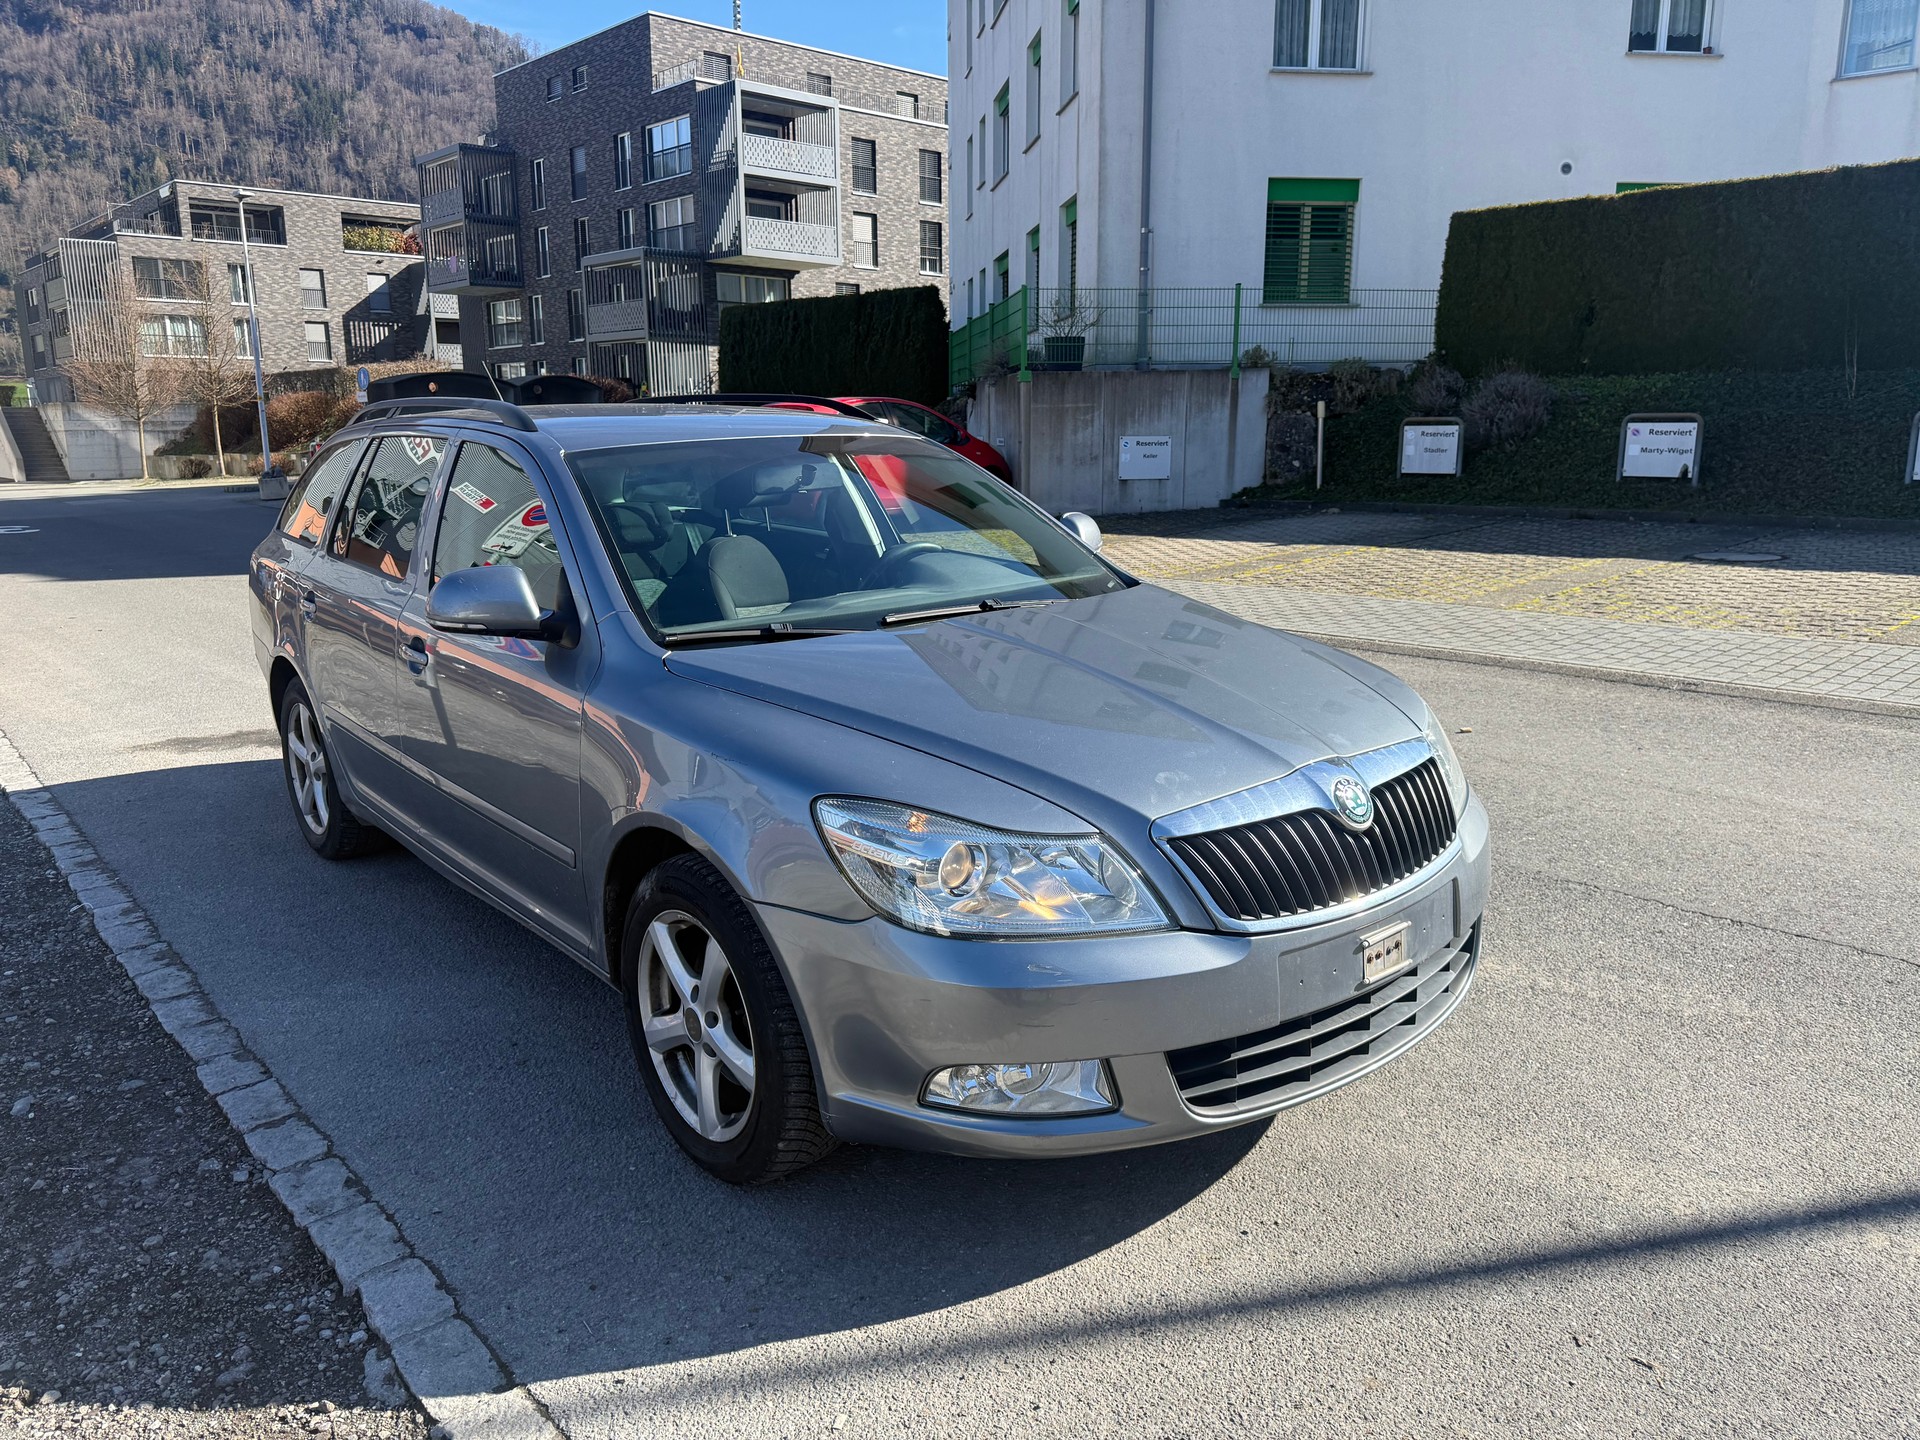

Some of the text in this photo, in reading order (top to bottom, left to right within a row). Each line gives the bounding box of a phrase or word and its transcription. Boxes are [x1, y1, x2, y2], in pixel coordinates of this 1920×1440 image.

[1420, 430, 1455, 438] Reserviert
[1648, 428, 1693, 436] Reserviert
[1640, 447, 1693, 455] Marty-Wiget
